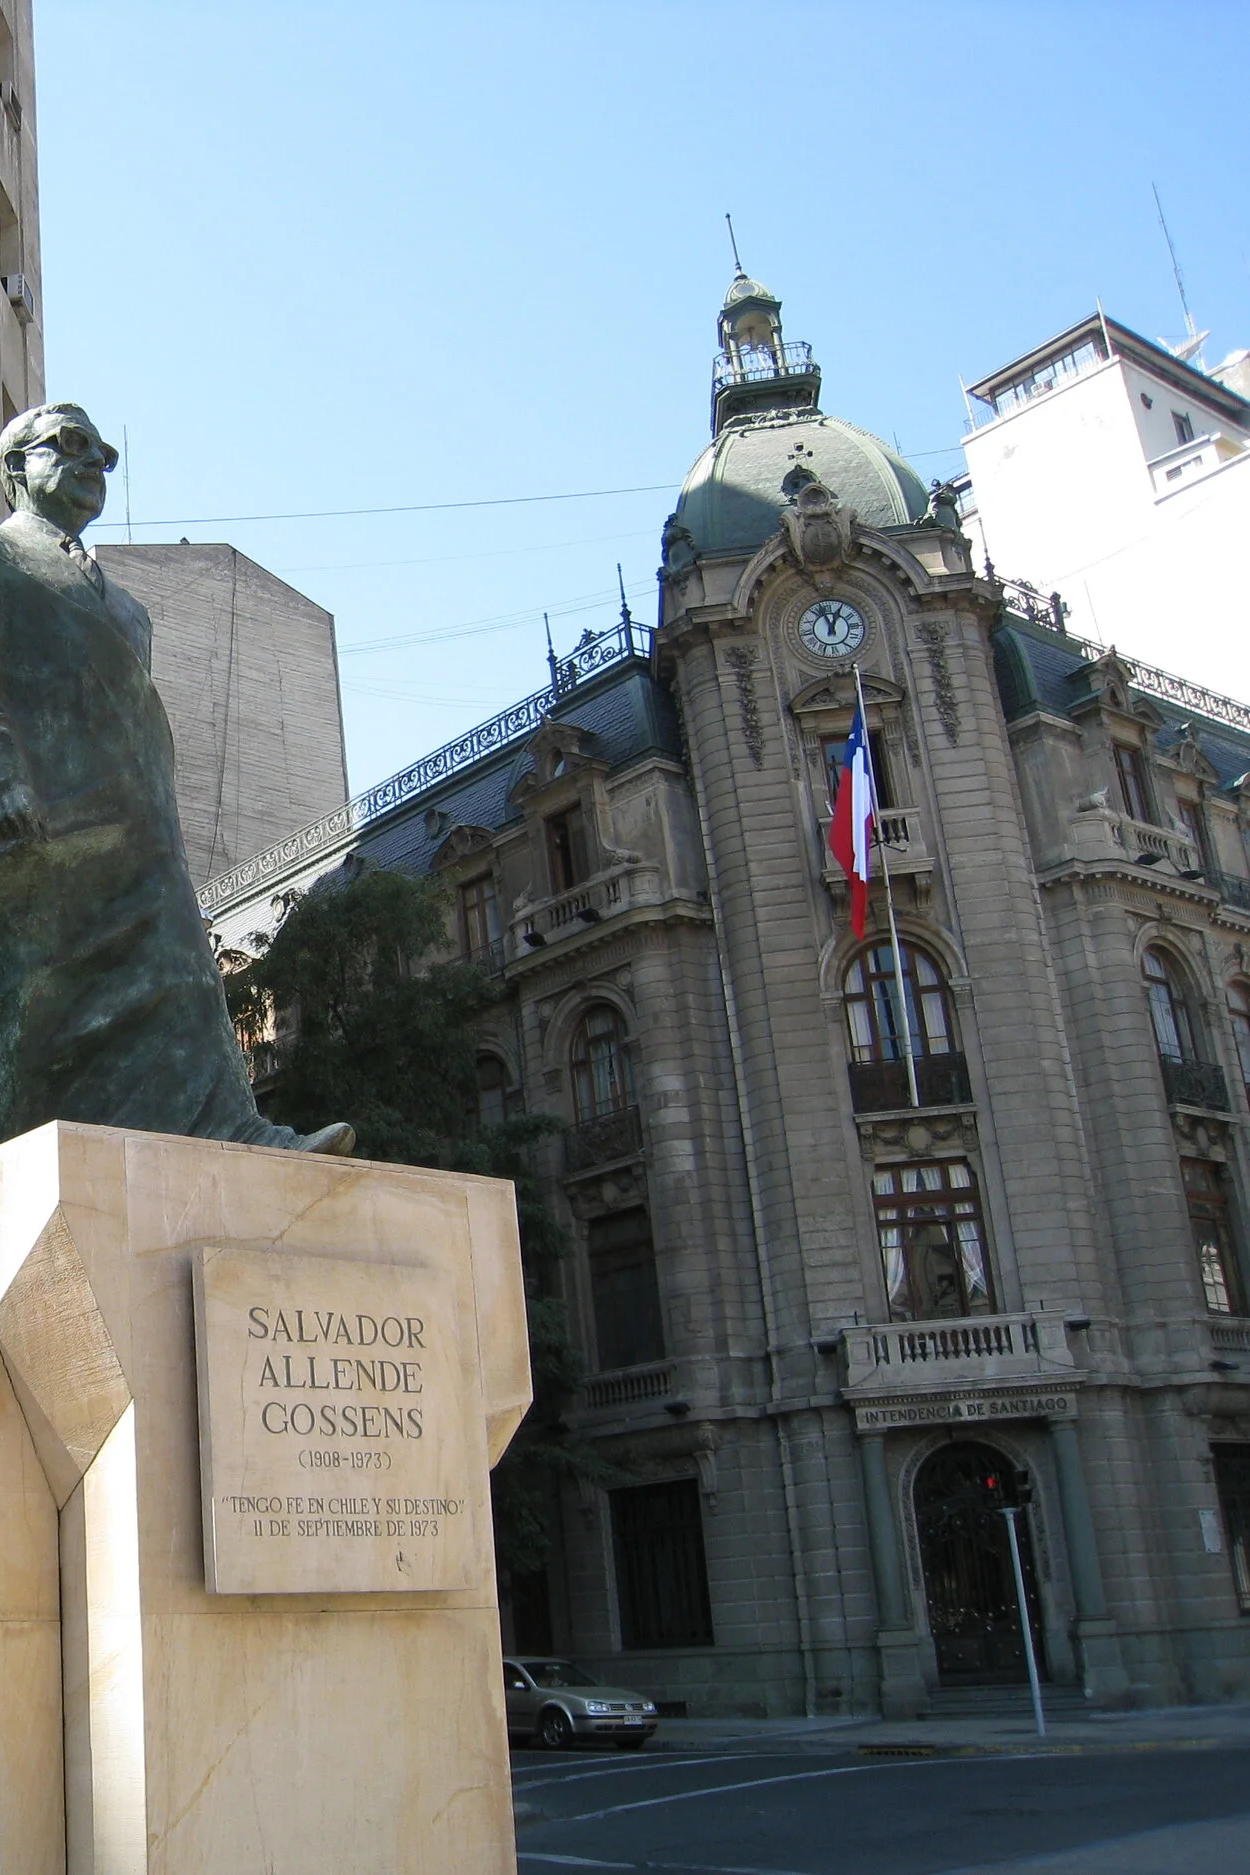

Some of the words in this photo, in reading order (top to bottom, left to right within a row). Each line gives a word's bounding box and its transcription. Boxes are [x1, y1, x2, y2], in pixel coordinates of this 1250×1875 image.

[248, 1306, 426, 1348] SALVADOR
[258, 1354, 423, 1394] ALLENDE
[261, 1401, 423, 1440] GOSSENS
[864, 1404, 964, 1425] INTENDENCIA
[966, 1402, 984, 1417] DE
[989, 1397, 1069, 1414] SANTIAGO
[298, 1449, 392, 1470] (1908-1973)
[286, 1497, 304, 1514] FE
[308, 1498, 325, 1514] EN
[328, 1498, 370, 1515] CHILE
[372, 1498, 382, 1515] Y
[386, 1499, 401, 1515] SU
[269, 1519, 291, 1537] DE
[297, 1517, 383, 1537] SEPTIEMBRE
[386, 1520, 406, 1537] DE
[409, 1520, 439, 1537] 1973
